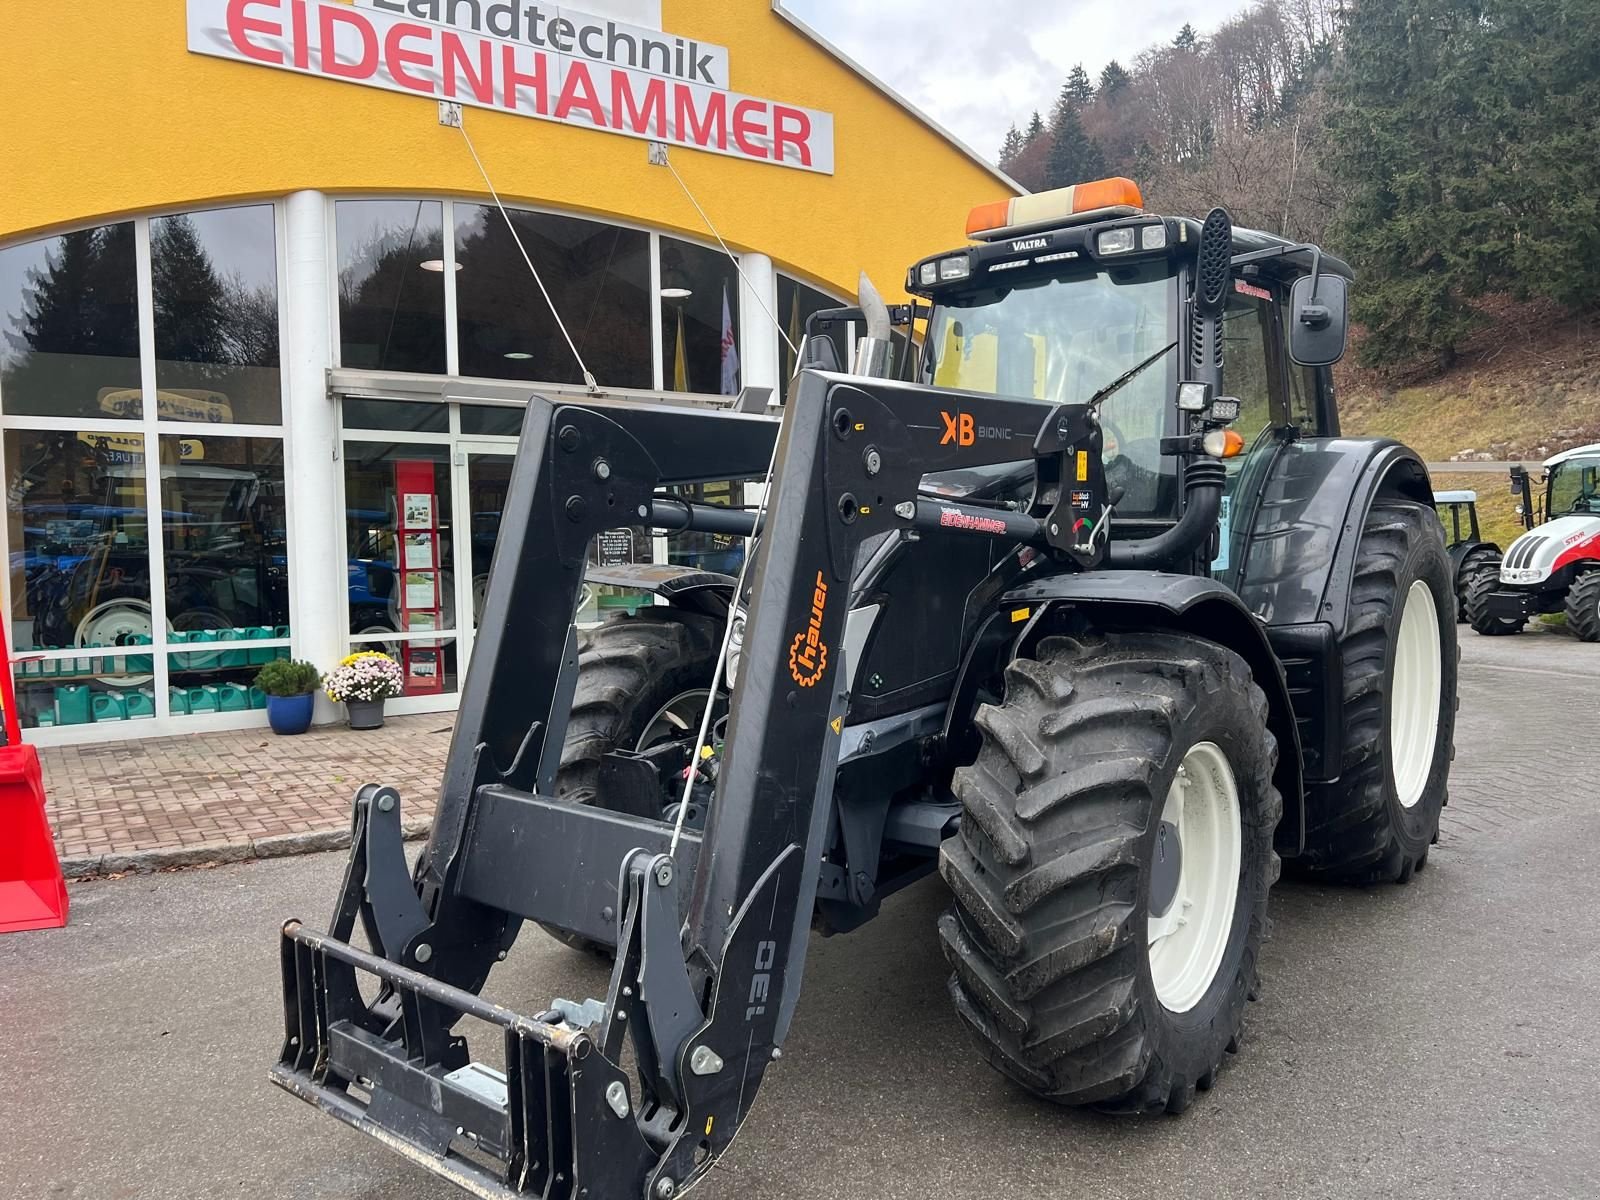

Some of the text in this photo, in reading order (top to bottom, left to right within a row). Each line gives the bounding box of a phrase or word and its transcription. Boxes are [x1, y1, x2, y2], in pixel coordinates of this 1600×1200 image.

[373, 0, 715, 84] andtechnik
[226, 0, 812, 167] EIDENHAMMER
[1012, 238, 1047, 251] VALTRA
[978, 426, 1012, 440] BIONIC
[1565, 531, 1585, 546] STEYR
[798, 570, 829, 670] hauer
[745, 941, 776, 1021] 130
